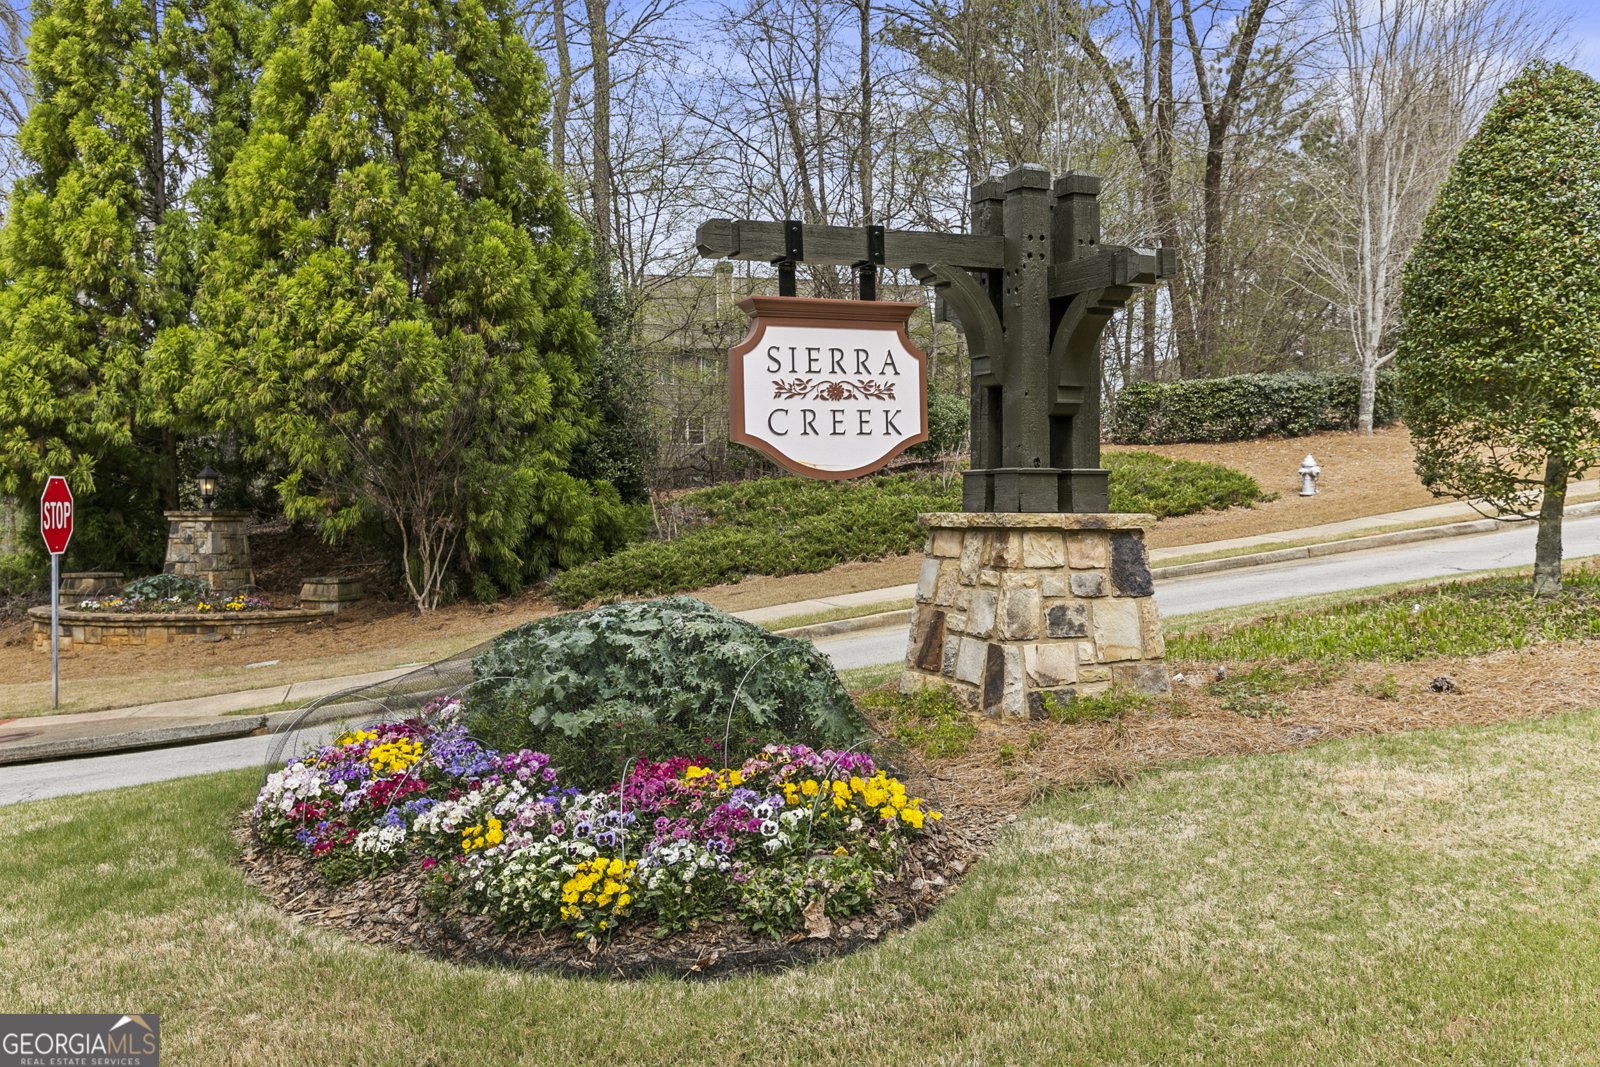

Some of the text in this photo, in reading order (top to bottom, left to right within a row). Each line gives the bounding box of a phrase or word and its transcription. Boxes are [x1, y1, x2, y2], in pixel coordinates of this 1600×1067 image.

[766, 345, 901, 376] SIERRA
[767, 408, 902, 436] CREEK
[43, 501, 71, 530] STOP
